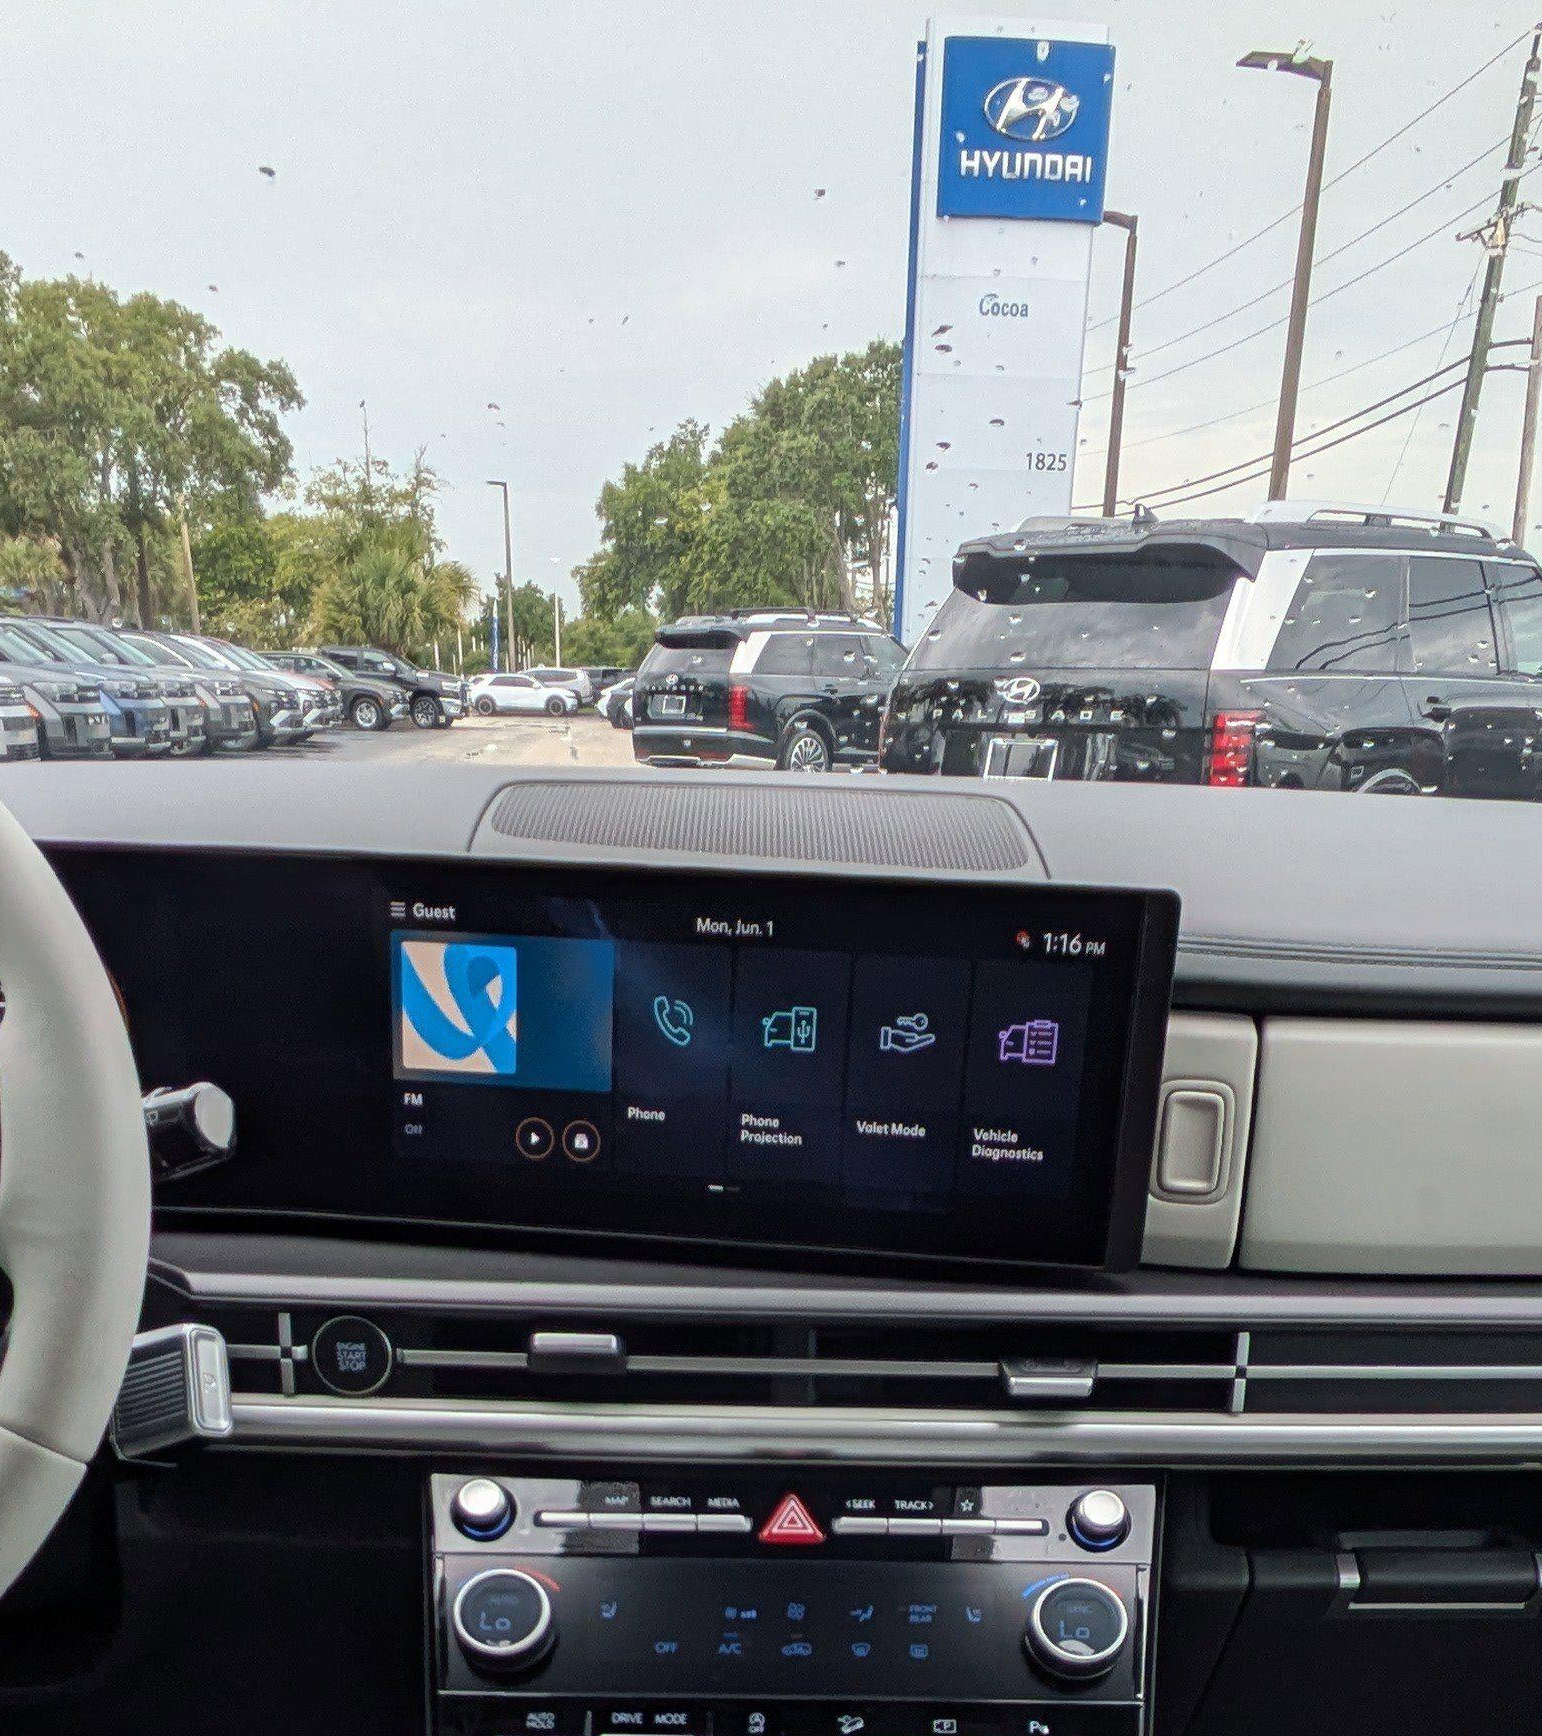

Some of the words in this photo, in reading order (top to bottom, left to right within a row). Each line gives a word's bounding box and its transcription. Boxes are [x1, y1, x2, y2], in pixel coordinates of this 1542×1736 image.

[960, 149, 1092, 183] HYUNDAI
[979, 294, 1029, 317] Cocoa
[1026, 452, 1067, 471] 1825
[413, 903, 456, 920] Guest
[697, 918, 732, 936] Mon,
[736, 918, 763, 936] Jun.
[766, 920, 773, 936] 1
[1044, 932, 1081, 955] 1:16
[1085, 941, 1107, 955] PM
[404, 1093, 423, 1106] FM
[628, 1107, 666, 1121] Phone
[742, 1114, 780, 1128] Phone
[857, 1120, 889, 1136] Valet
[891, 1123, 926, 1137] Mode
[974, 1128, 1018, 1143] Vehicle
[740, 1130, 803, 1146] Projection
[972, 1144, 1044, 1162] Diagnostics
[650, 1496, 692, 1507] SEARCH
[707, 1497, 740, 1508] MEDIA
[611, 1712, 644, 1725] DRIVE
[654, 1712, 688, 1725] MODE
